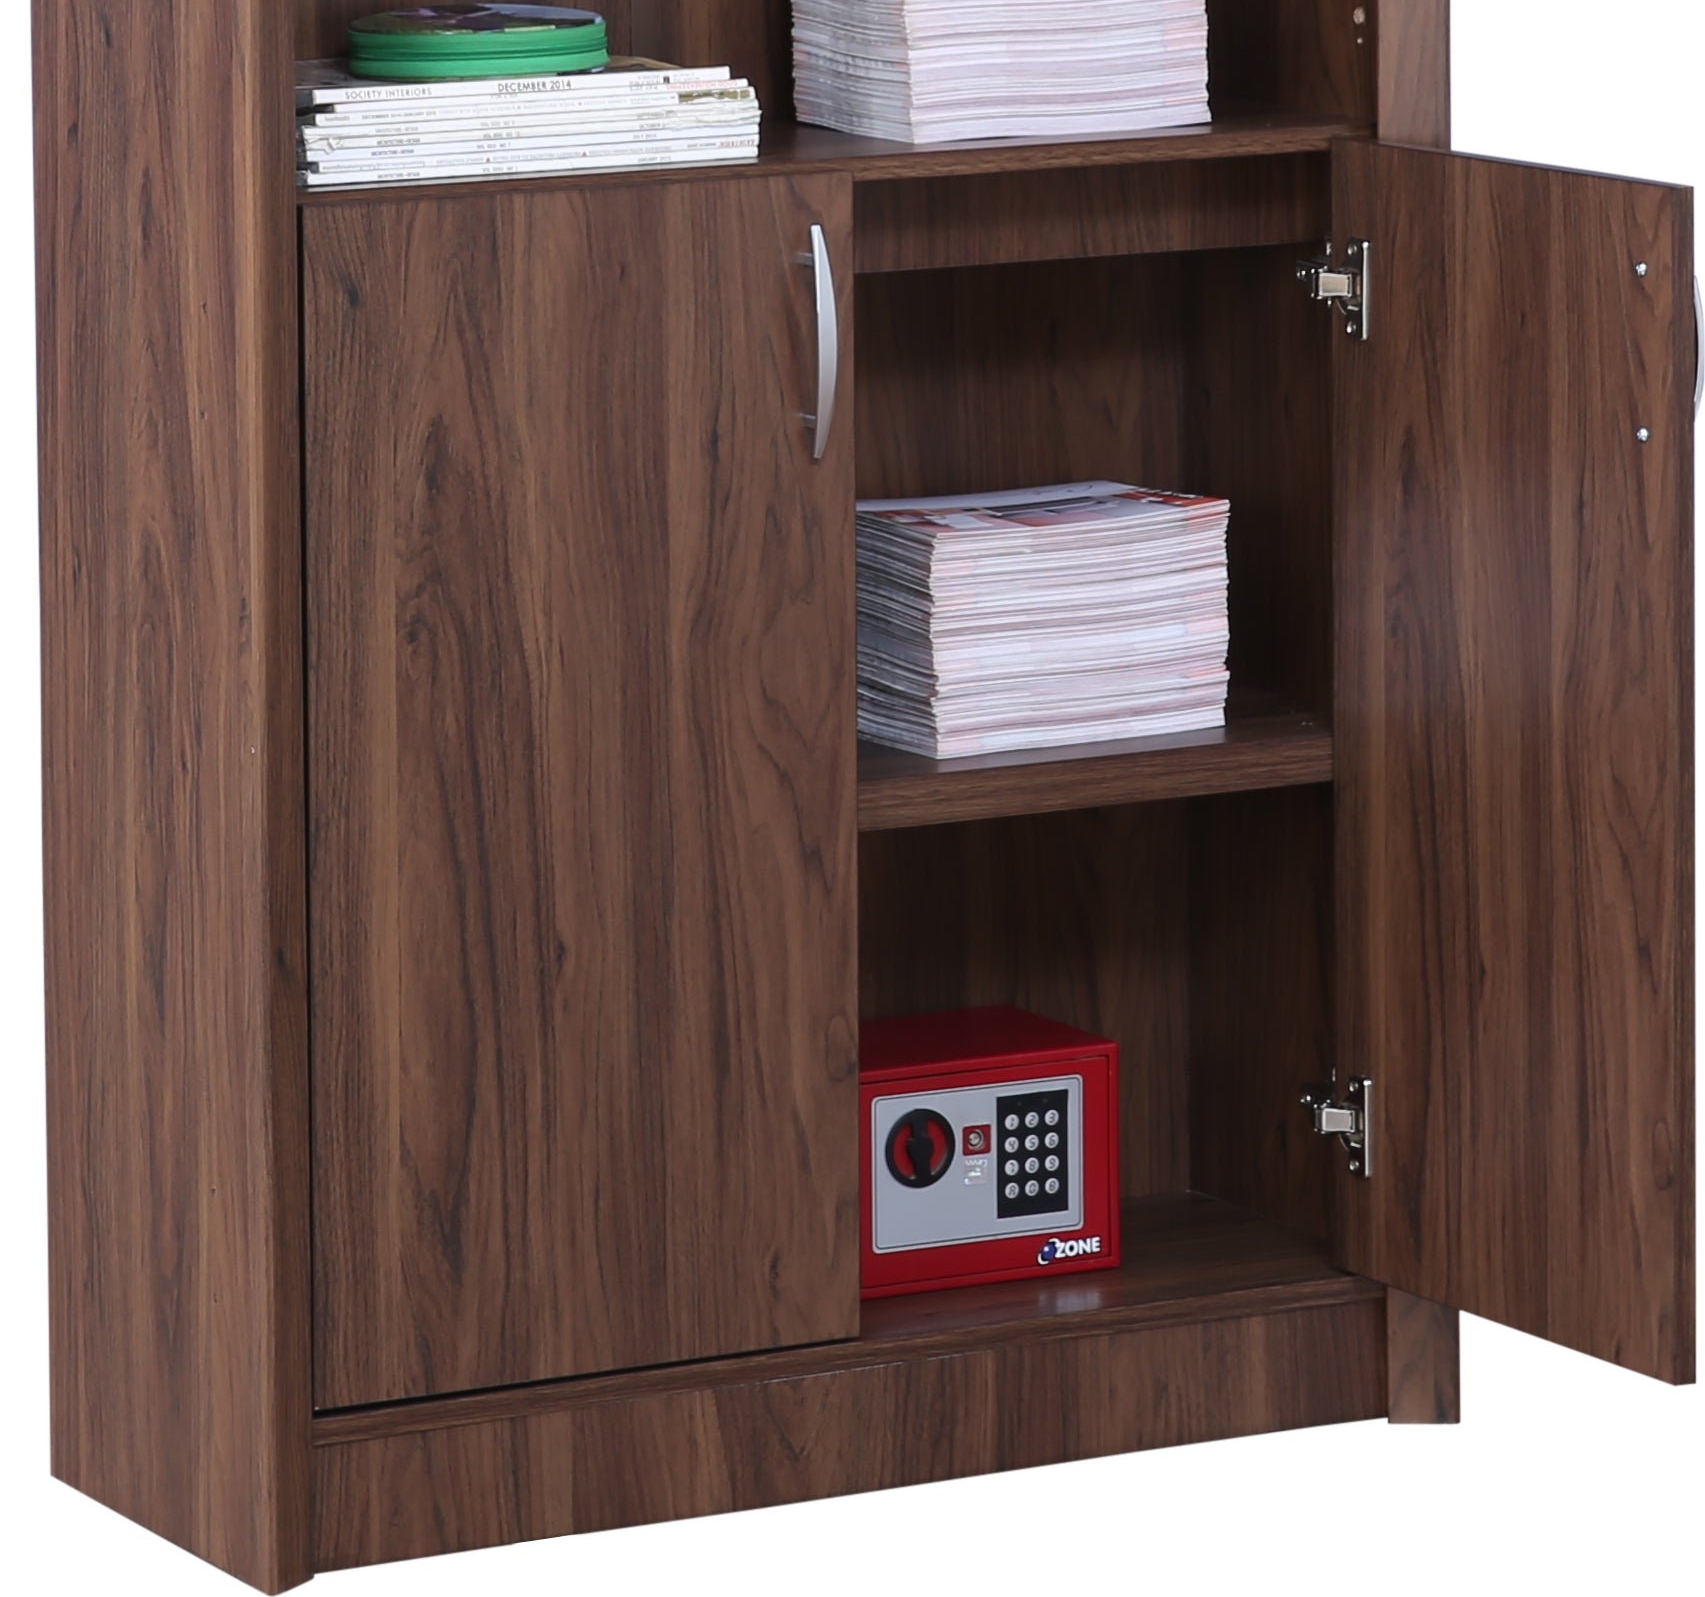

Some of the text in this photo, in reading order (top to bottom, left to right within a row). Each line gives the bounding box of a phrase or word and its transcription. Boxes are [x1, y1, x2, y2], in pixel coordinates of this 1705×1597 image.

[498, 80, 572, 92] DECEMBER 2014
[345, 87, 432, 100] SOCIETY INTERIORS
